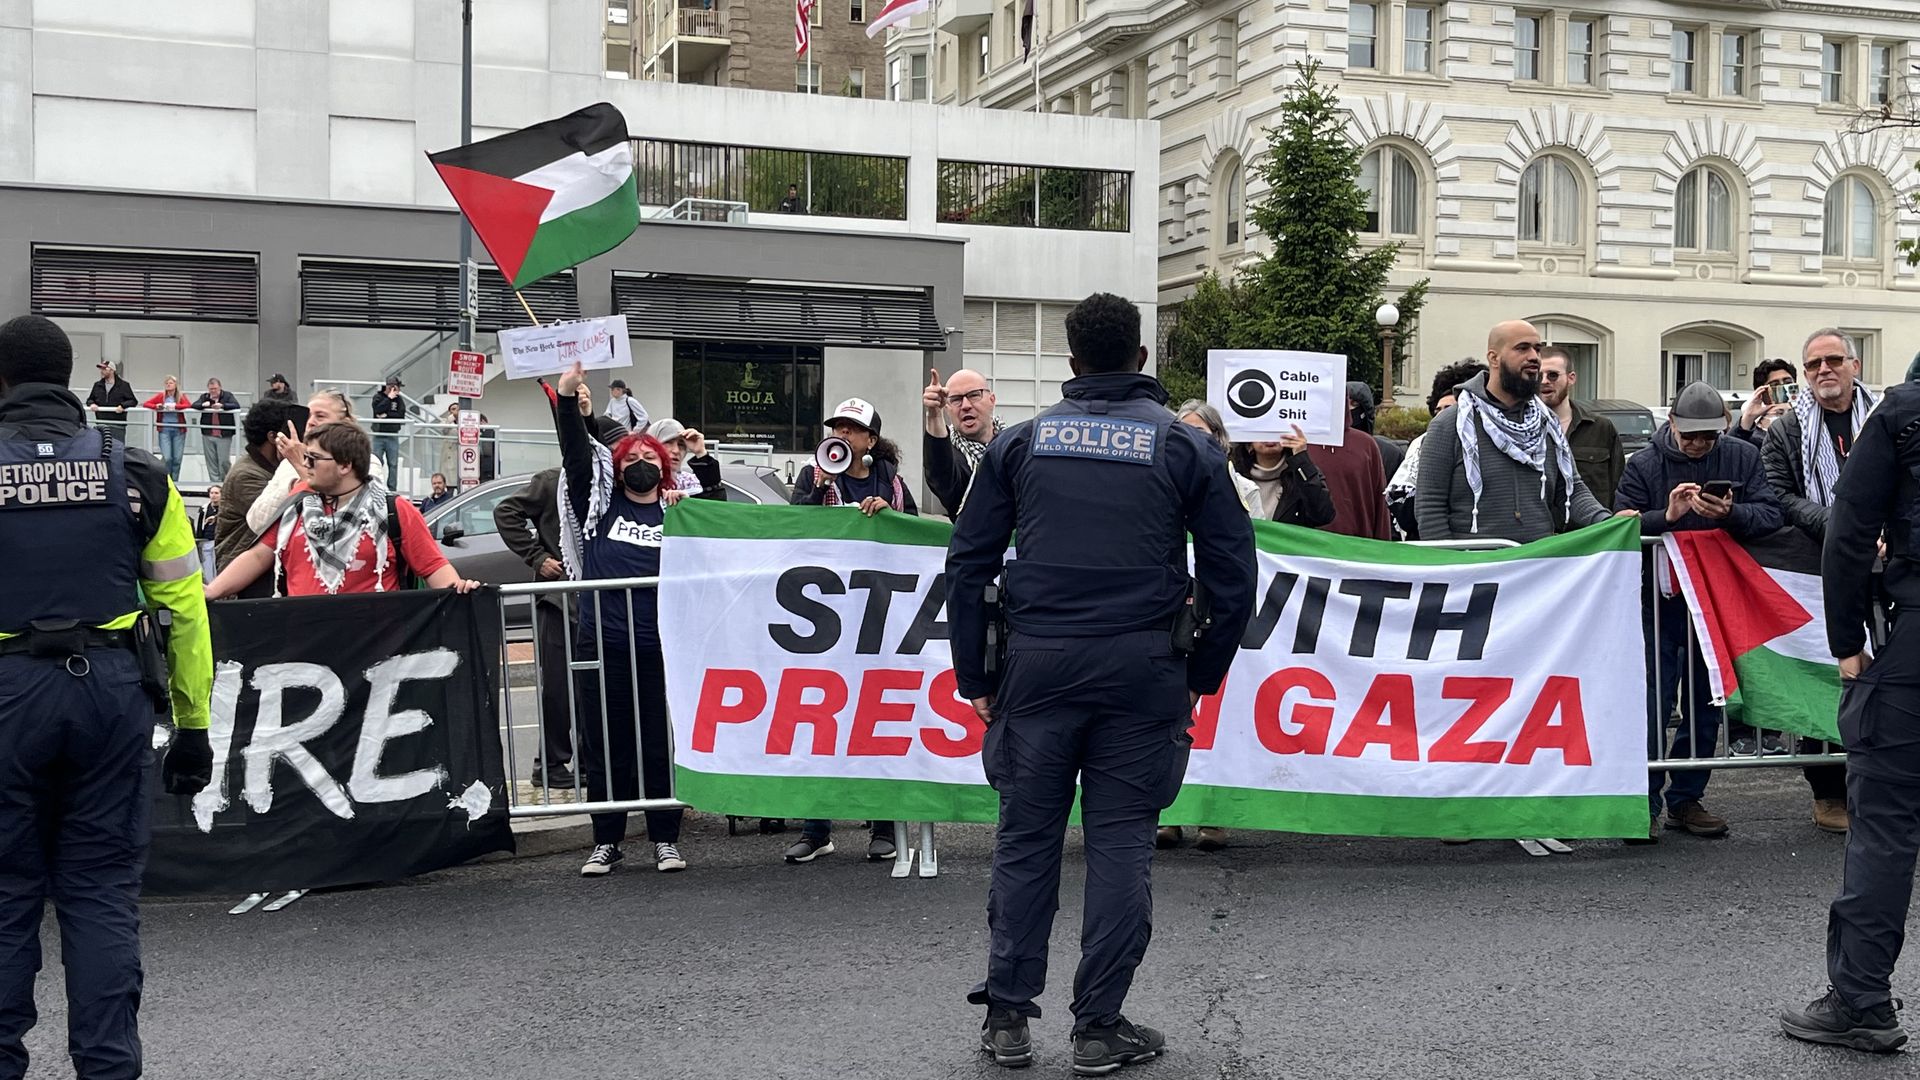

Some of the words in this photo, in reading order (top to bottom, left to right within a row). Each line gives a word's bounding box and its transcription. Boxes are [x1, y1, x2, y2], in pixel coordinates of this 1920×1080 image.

[512, 347, 525, 355] The
[525, 344, 539, 353] New
[539, 341, 556, 352] York
[459, 353, 478, 362] SNOW
[457, 365, 476, 373] ROUTE
[1279, 370, 1319, 382] Cable
[727, 391, 775, 404] HOJA
[1279, 390, 1306, 400] Bull
[1278, 408, 1307, 420] Shit
[1039, 421, 1155, 435] METROPOLITAN
[1039, 426, 1151, 452] POLICE
[1064, 444, 1109, 455] TRAINING
[1111, 449, 1151, 460] OFFICER
[0, 462, 108, 484] ETROPOLITAN
[0, 481, 106, 505] POLICE
[617, 522, 662, 541] PRES
[768, 566, 949, 655] STA
[692, 668, 988, 758] PRES
[1254, 667, 1592, 766] GAZA
[191, 646, 492, 833] IRE.
